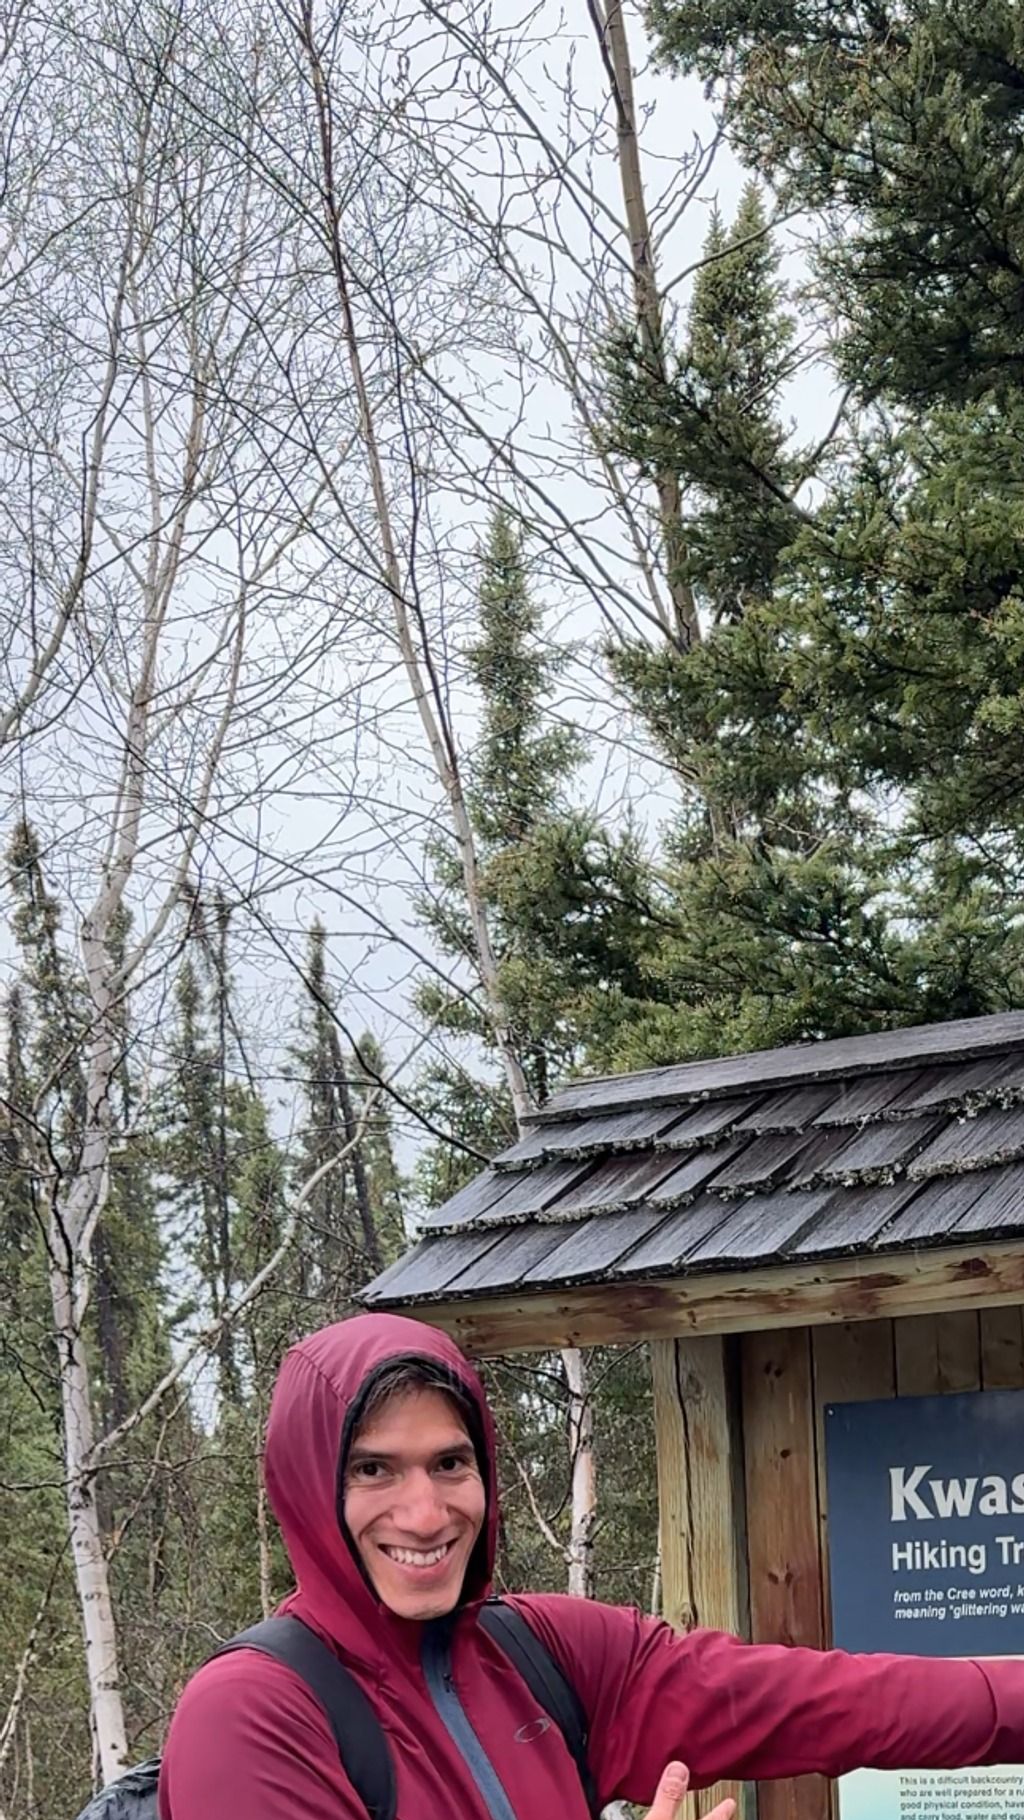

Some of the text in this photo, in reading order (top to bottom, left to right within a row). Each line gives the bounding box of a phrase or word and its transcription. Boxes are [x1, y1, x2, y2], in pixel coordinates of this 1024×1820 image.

[892, 1539, 986, 1575] Hiking
[893, 1590, 921, 1603] from
[924, 1588, 944, 1601] the
[946, 1587, 976, 1600] Cree
[979, 1584, 1013, 1599] word,
[894, 1604, 946, 1620] meaning
